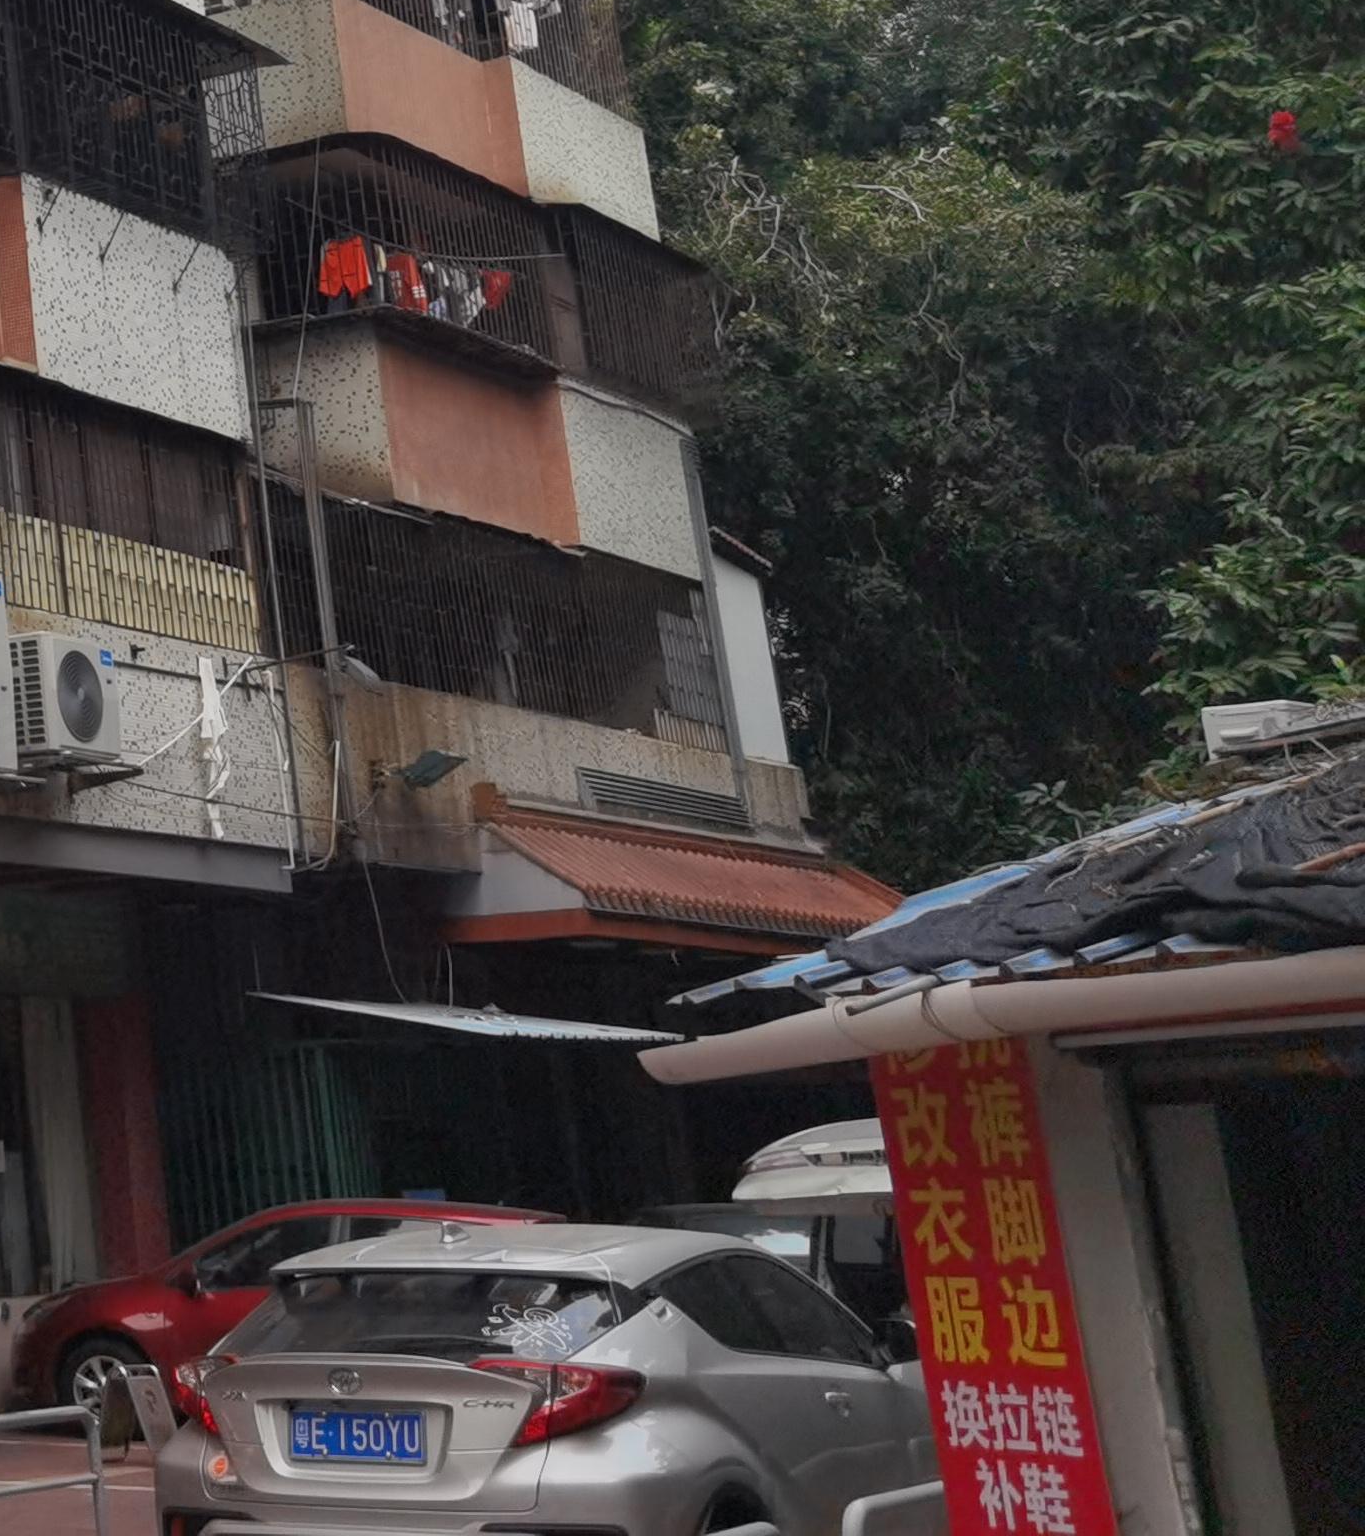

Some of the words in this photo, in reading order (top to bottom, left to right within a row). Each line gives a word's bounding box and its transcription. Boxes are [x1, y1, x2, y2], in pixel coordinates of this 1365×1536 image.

[940, 1379, 1084, 1458] 换拉链
[975, 1458, 1077, 1535] 补鞋
